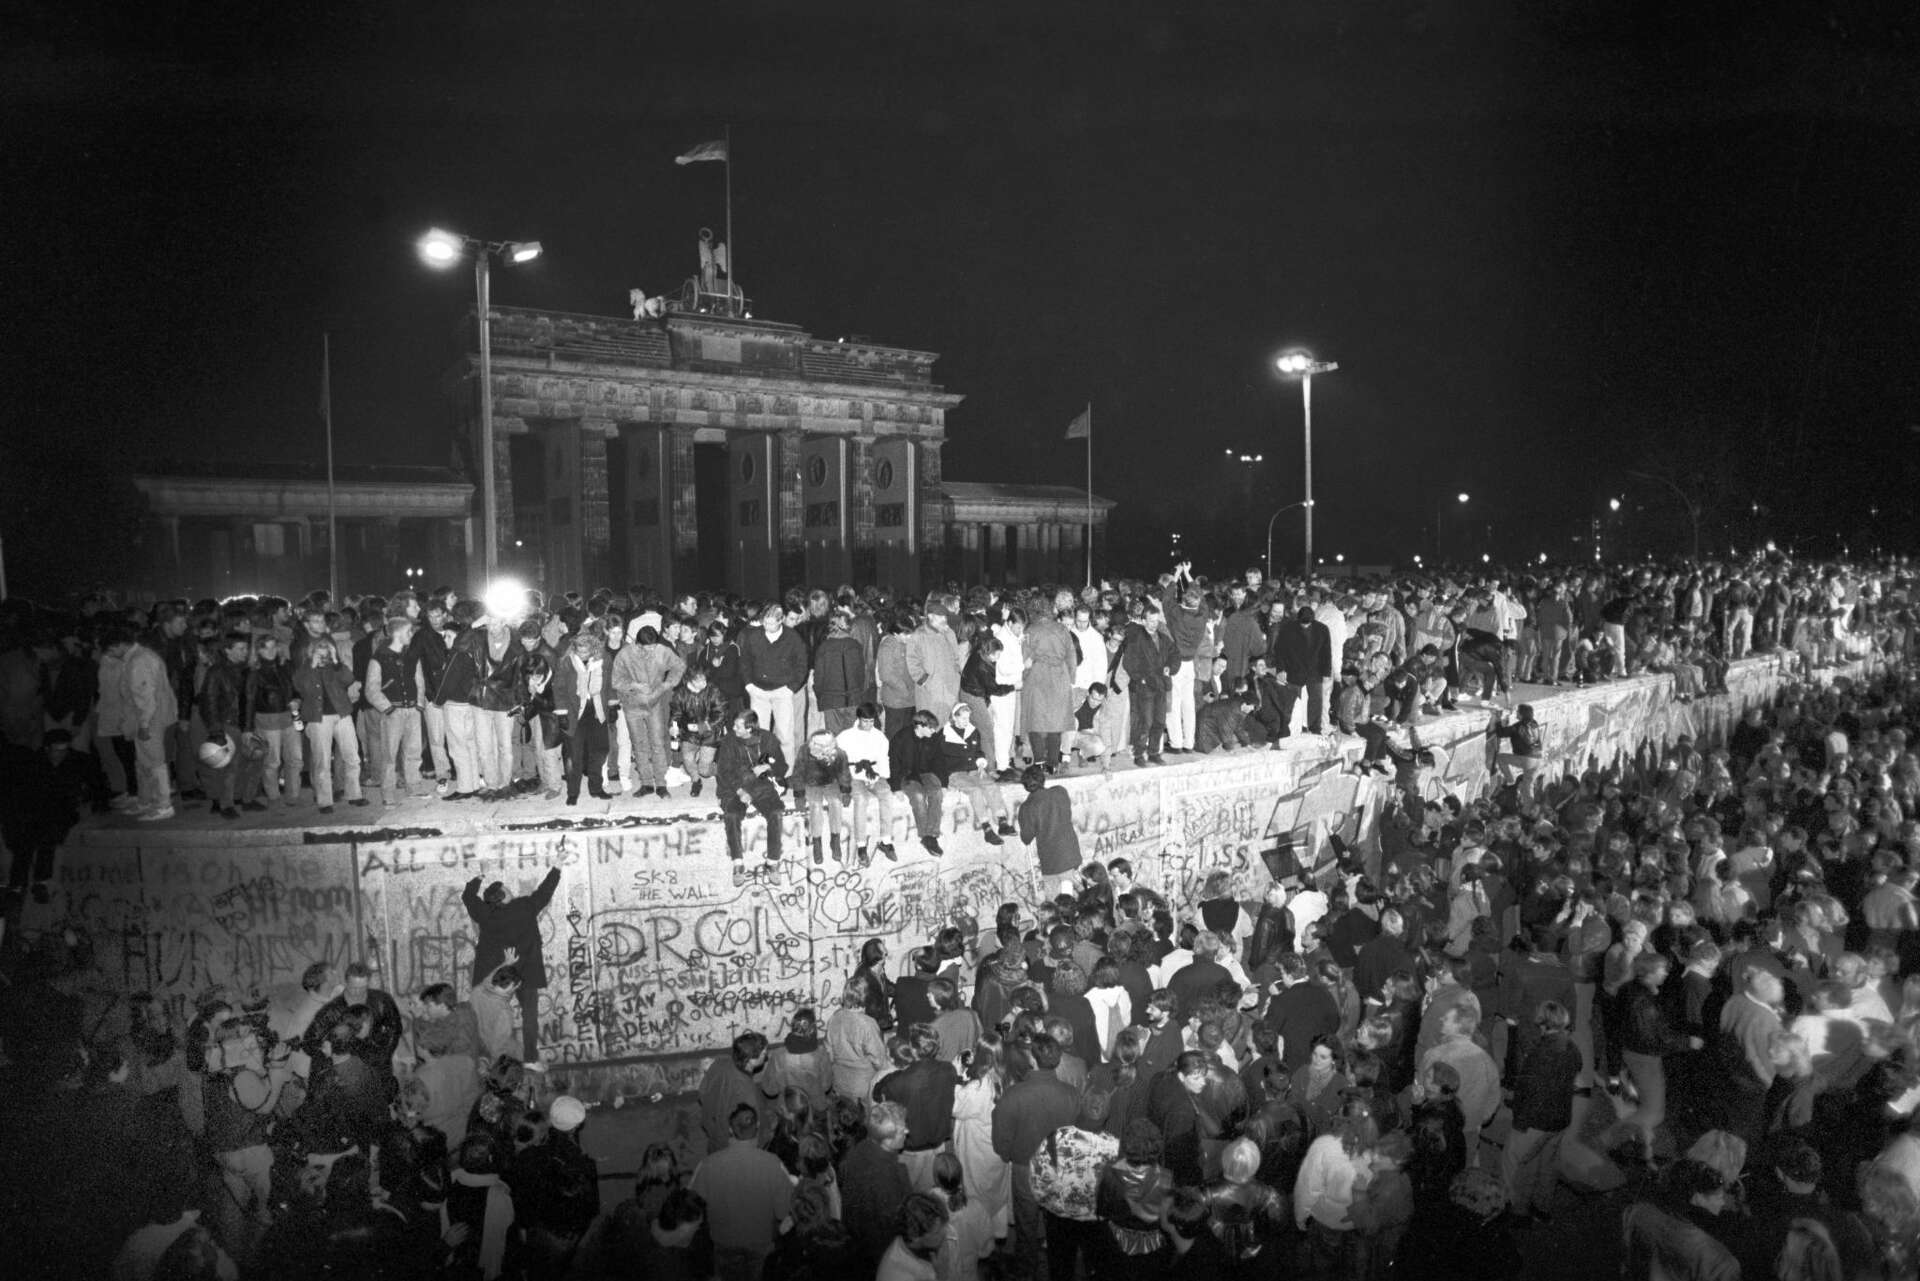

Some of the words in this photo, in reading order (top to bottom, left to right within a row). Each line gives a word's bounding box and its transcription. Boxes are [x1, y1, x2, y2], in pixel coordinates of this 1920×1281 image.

[362, 846, 425, 877] ALL
[440, 840, 476, 869] OF
[597, 834, 624, 864] IN
[634, 827, 707, 858] THE
[633, 869, 678, 887] SK8
[632, 886, 662, 900] THE
[668, 883, 720, 900] WALL
